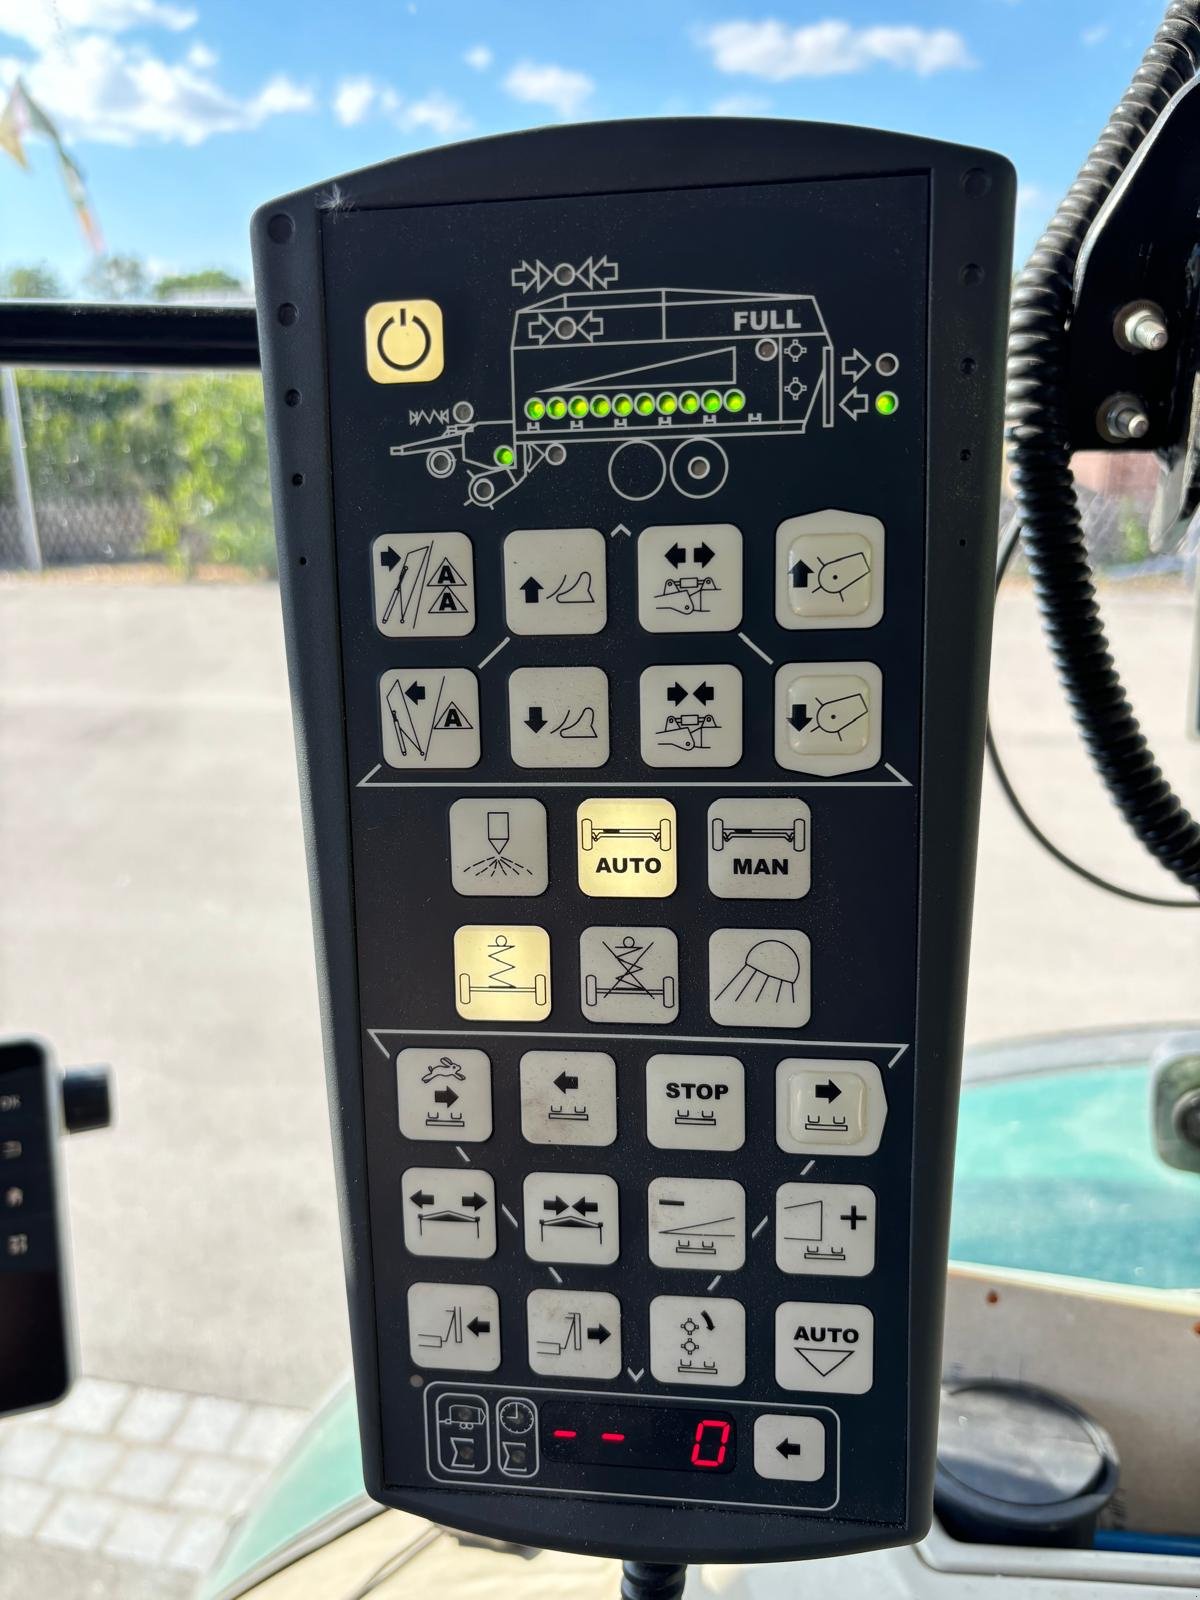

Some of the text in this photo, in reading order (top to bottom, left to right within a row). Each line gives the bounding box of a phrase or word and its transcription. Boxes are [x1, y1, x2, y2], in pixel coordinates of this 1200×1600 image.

[733, 309, 801, 331] FULL
[437, 565, 456, 584] A
[438, 592, 458, 611] A
[443, 708, 463, 728] A
[595, 857, 662, 874] AUTO
[732, 858, 789, 875] MAN
[665, 1082, 729, 1100] STOP
[793, 1325, 859, 1344] AUTO
